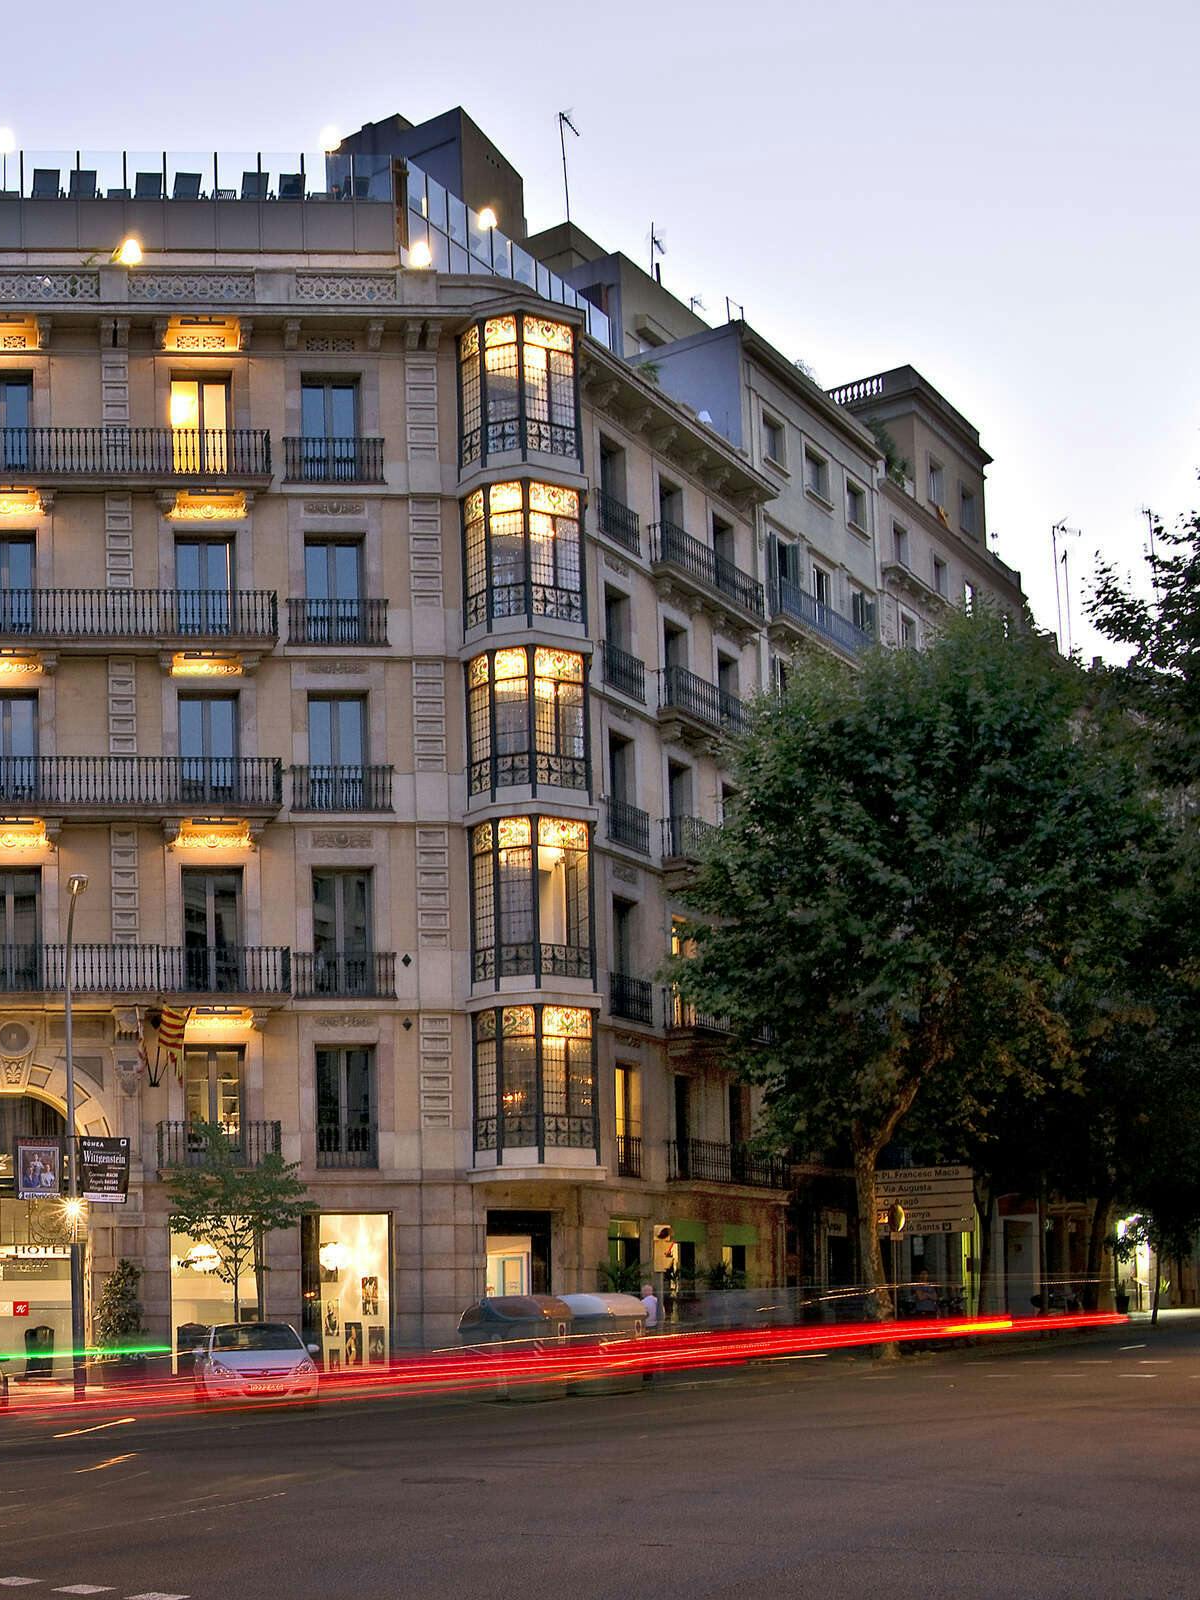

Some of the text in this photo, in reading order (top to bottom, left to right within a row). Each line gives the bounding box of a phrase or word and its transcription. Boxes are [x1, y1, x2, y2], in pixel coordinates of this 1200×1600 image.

[83, 1150, 126, 1165] Wittgenstein
[897, 1185, 932, 1194] Augusta
[916, 1223, 940, 1231] Sants
[15, 1246, 71, 1255] HOTEL
